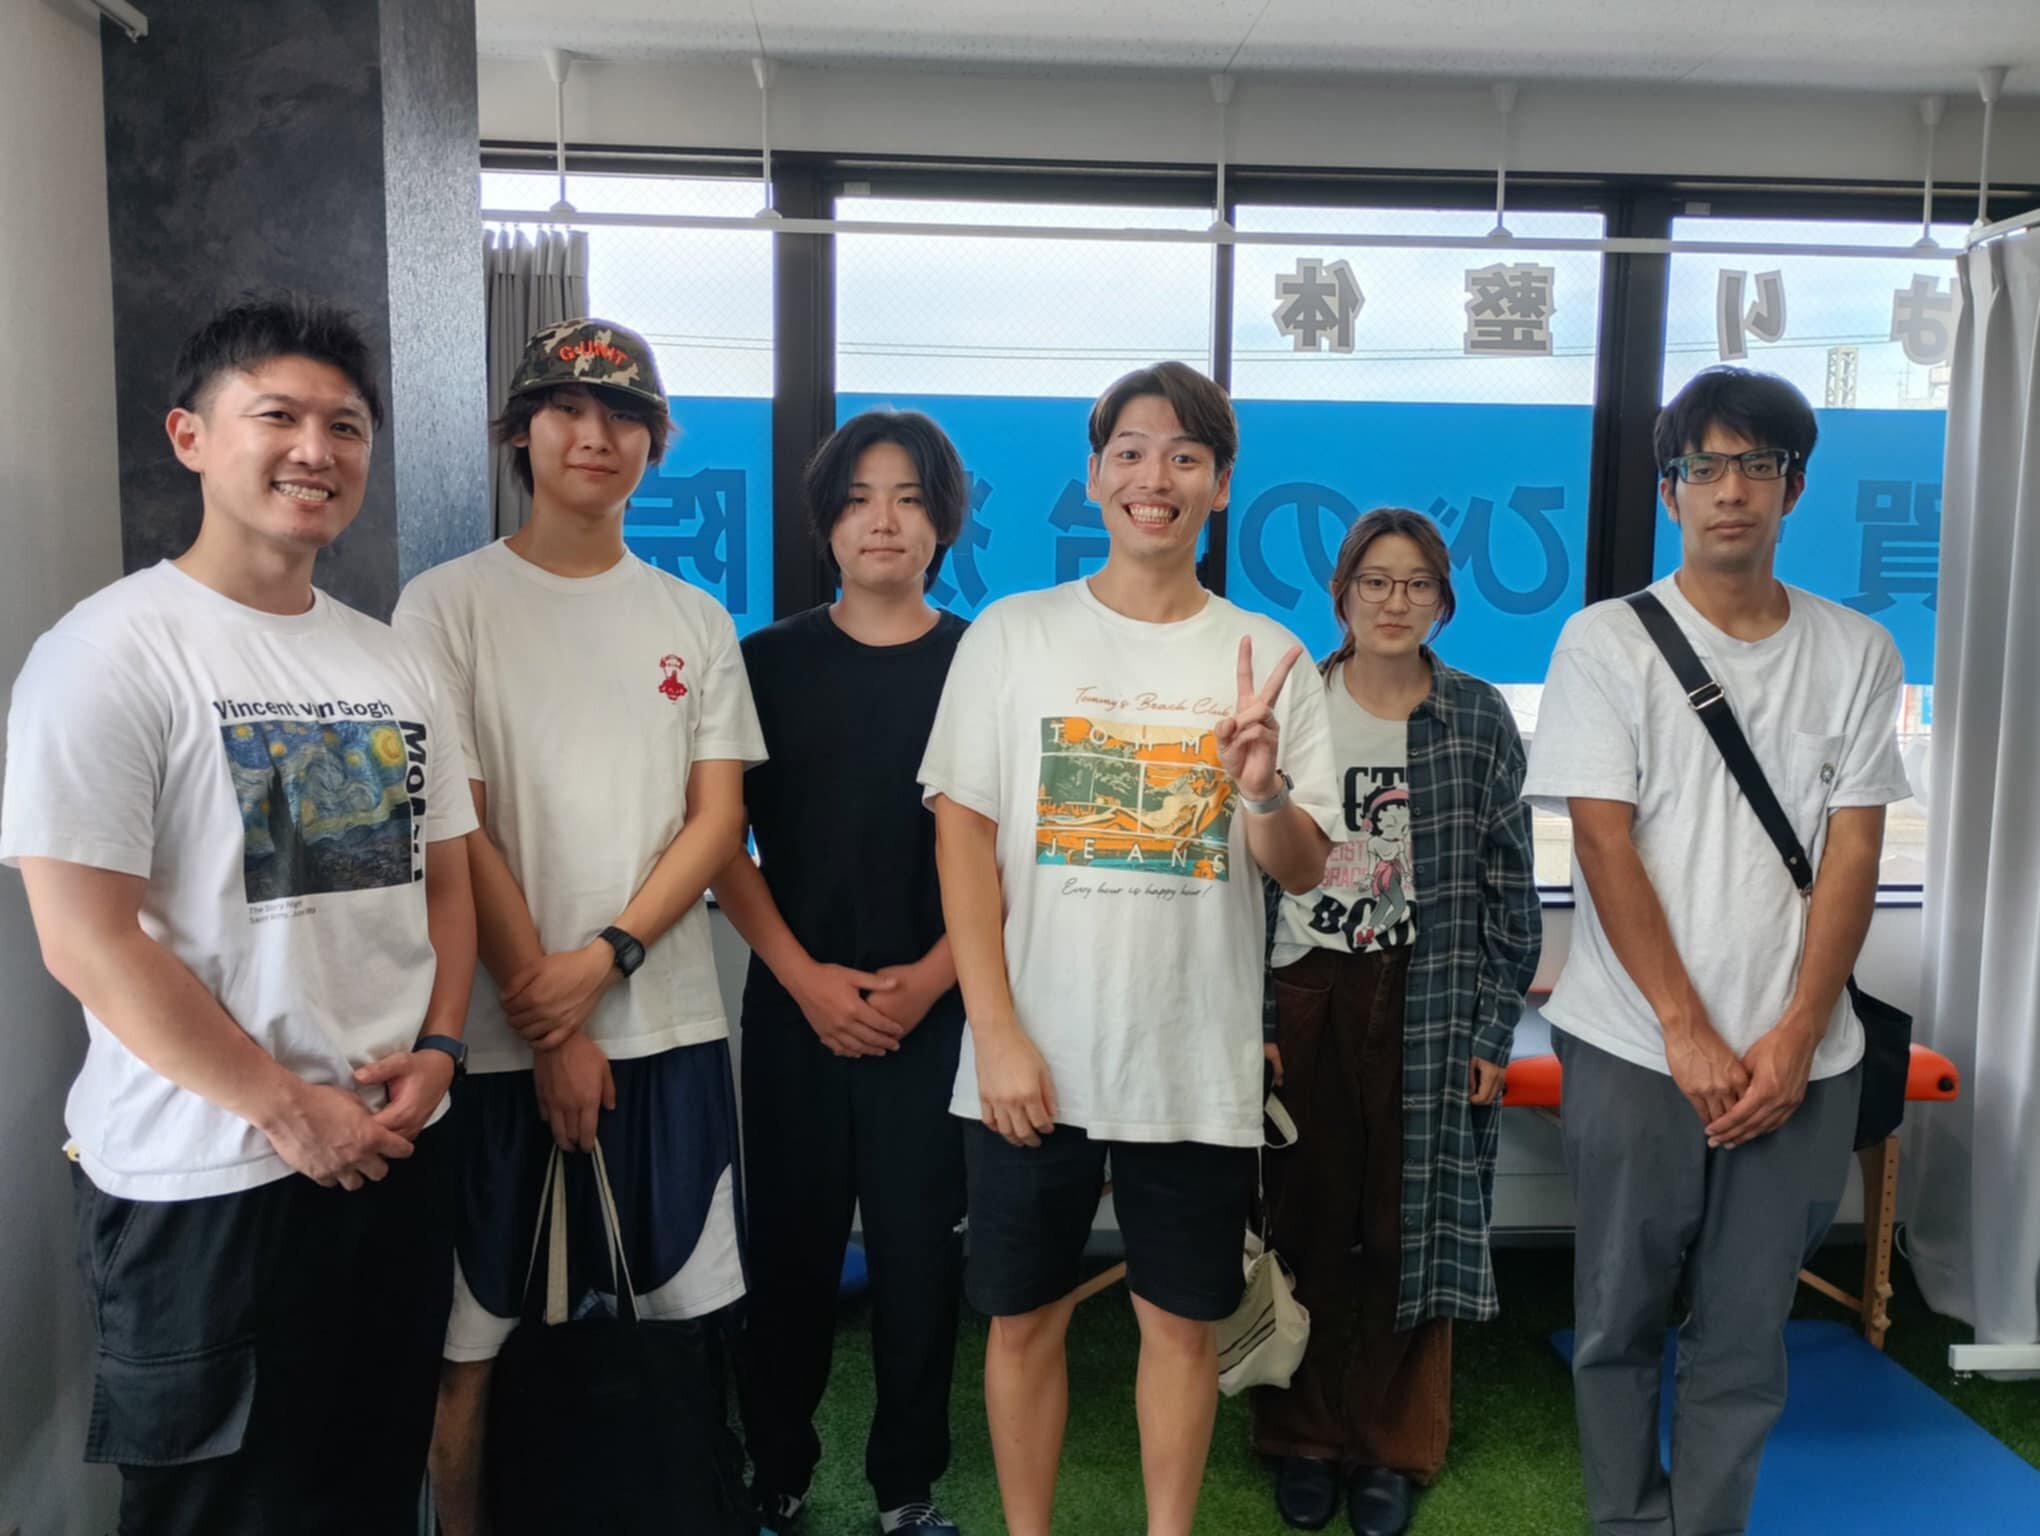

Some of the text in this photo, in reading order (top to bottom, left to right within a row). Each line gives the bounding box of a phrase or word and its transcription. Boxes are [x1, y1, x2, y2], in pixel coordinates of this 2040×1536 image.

[213, 699, 298, 720] Vincent
[337, 699, 394, 718] Gogh
[1135, 691, 1187, 711] Beach
[1049, 723, 1200, 754] TOMM
[1045, 838, 1226, 873] JEANS
